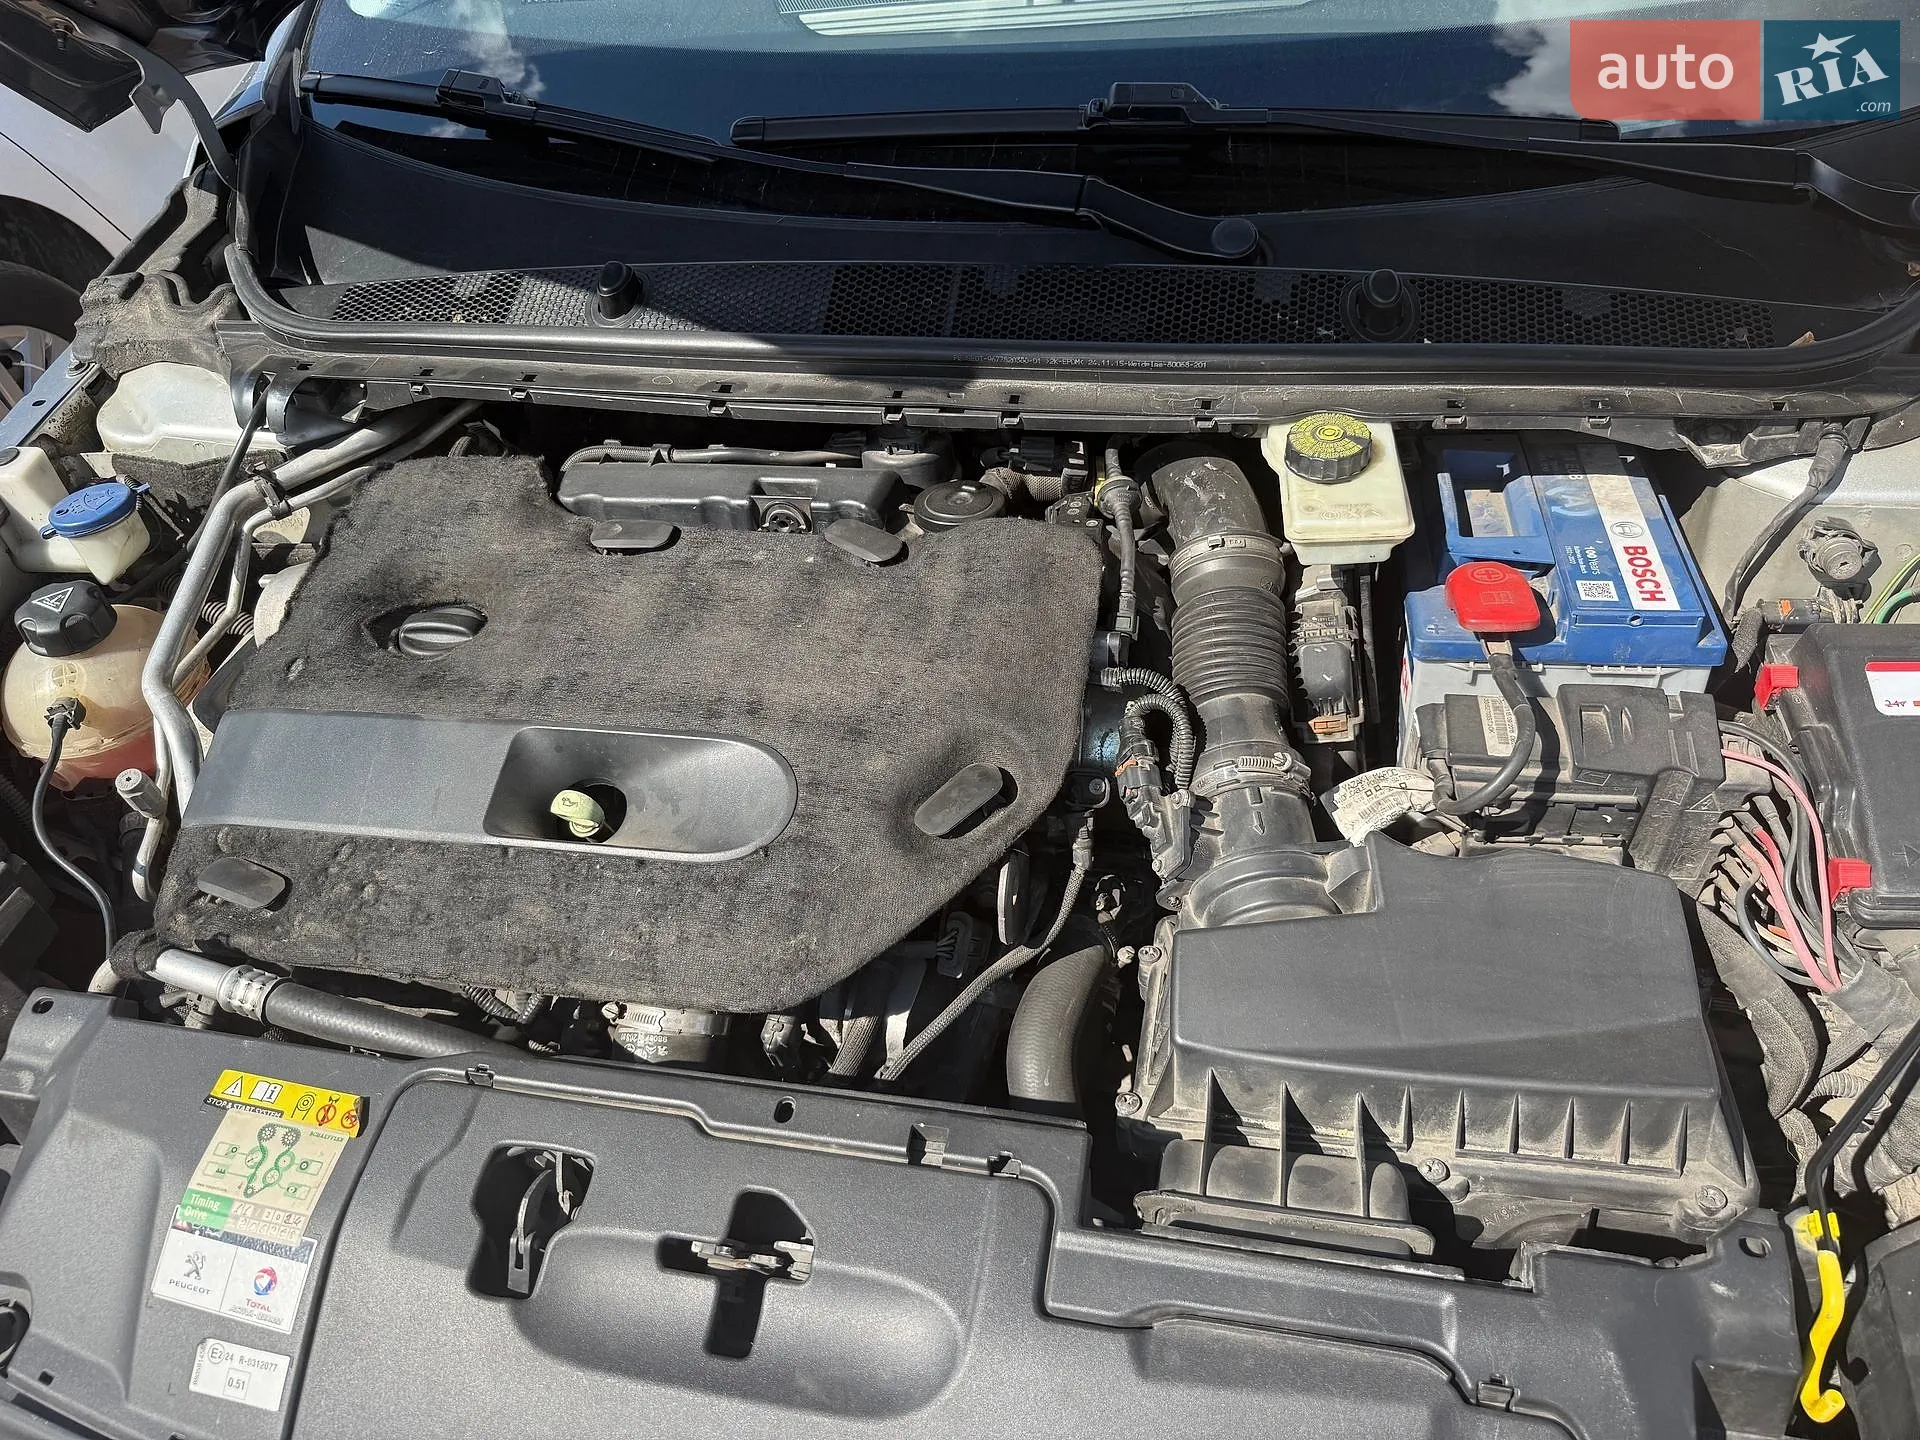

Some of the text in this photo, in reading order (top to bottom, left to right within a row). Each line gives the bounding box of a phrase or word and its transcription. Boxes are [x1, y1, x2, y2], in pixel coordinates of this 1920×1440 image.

[1623, 546, 1667, 603] BOSCH
[206, 1097, 226, 1108] STOP
[190, 1193, 221, 1211] Timing
[184, 1206, 208, 1221] Drive
[168, 1278, 212, 1296] PEUGEOT
[246, 1297, 272, 1313] TOTAL
[224, 1352, 234, 1361] 24
[227, 1376, 245, 1391] 0.51
